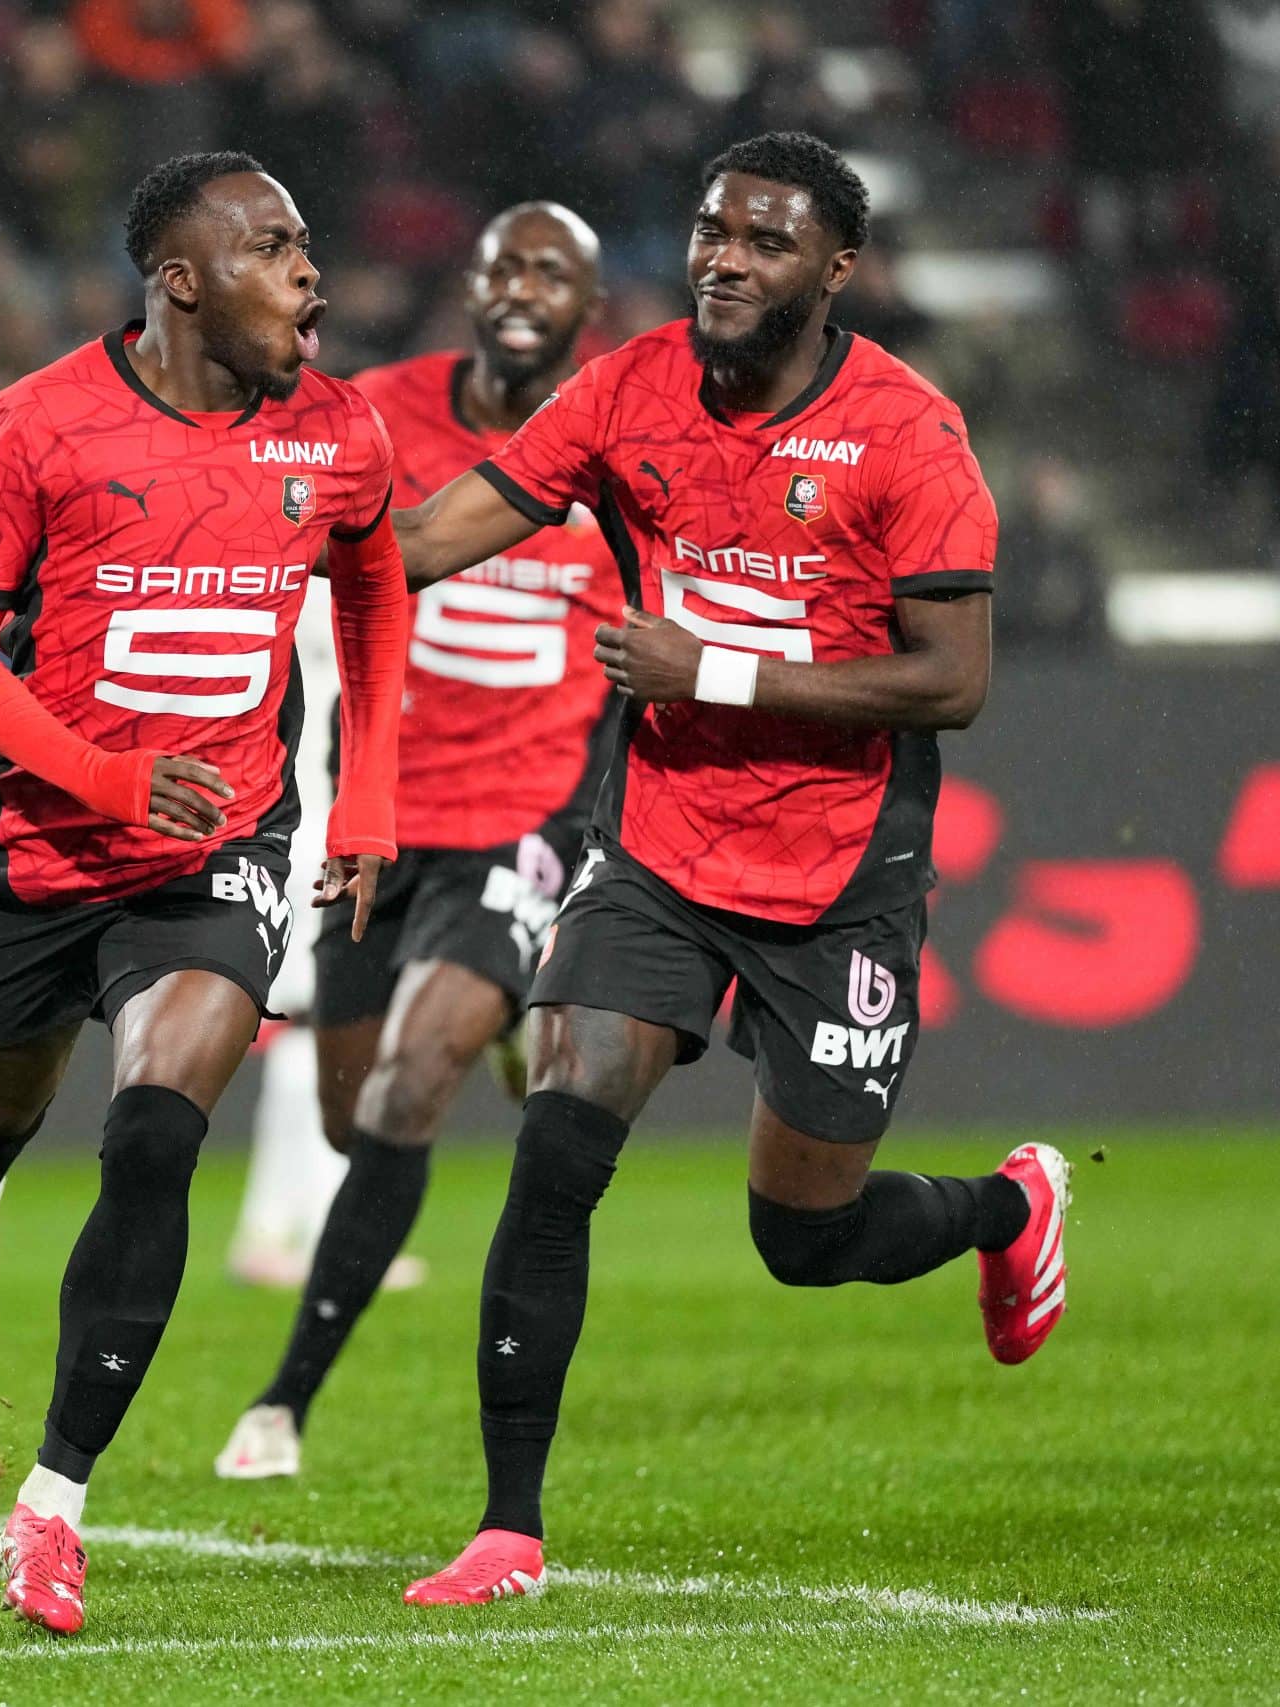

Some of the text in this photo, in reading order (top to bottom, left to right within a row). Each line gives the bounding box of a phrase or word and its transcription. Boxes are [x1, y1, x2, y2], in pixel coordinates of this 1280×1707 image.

[249, 440, 338, 466] LAUNAY
[771, 436, 865, 465] LAUNAY
[96, 564, 307, 594] SAMSIC
[458, 556, 593, 595] MSIC
[810, 1020, 910, 1069] BWT
